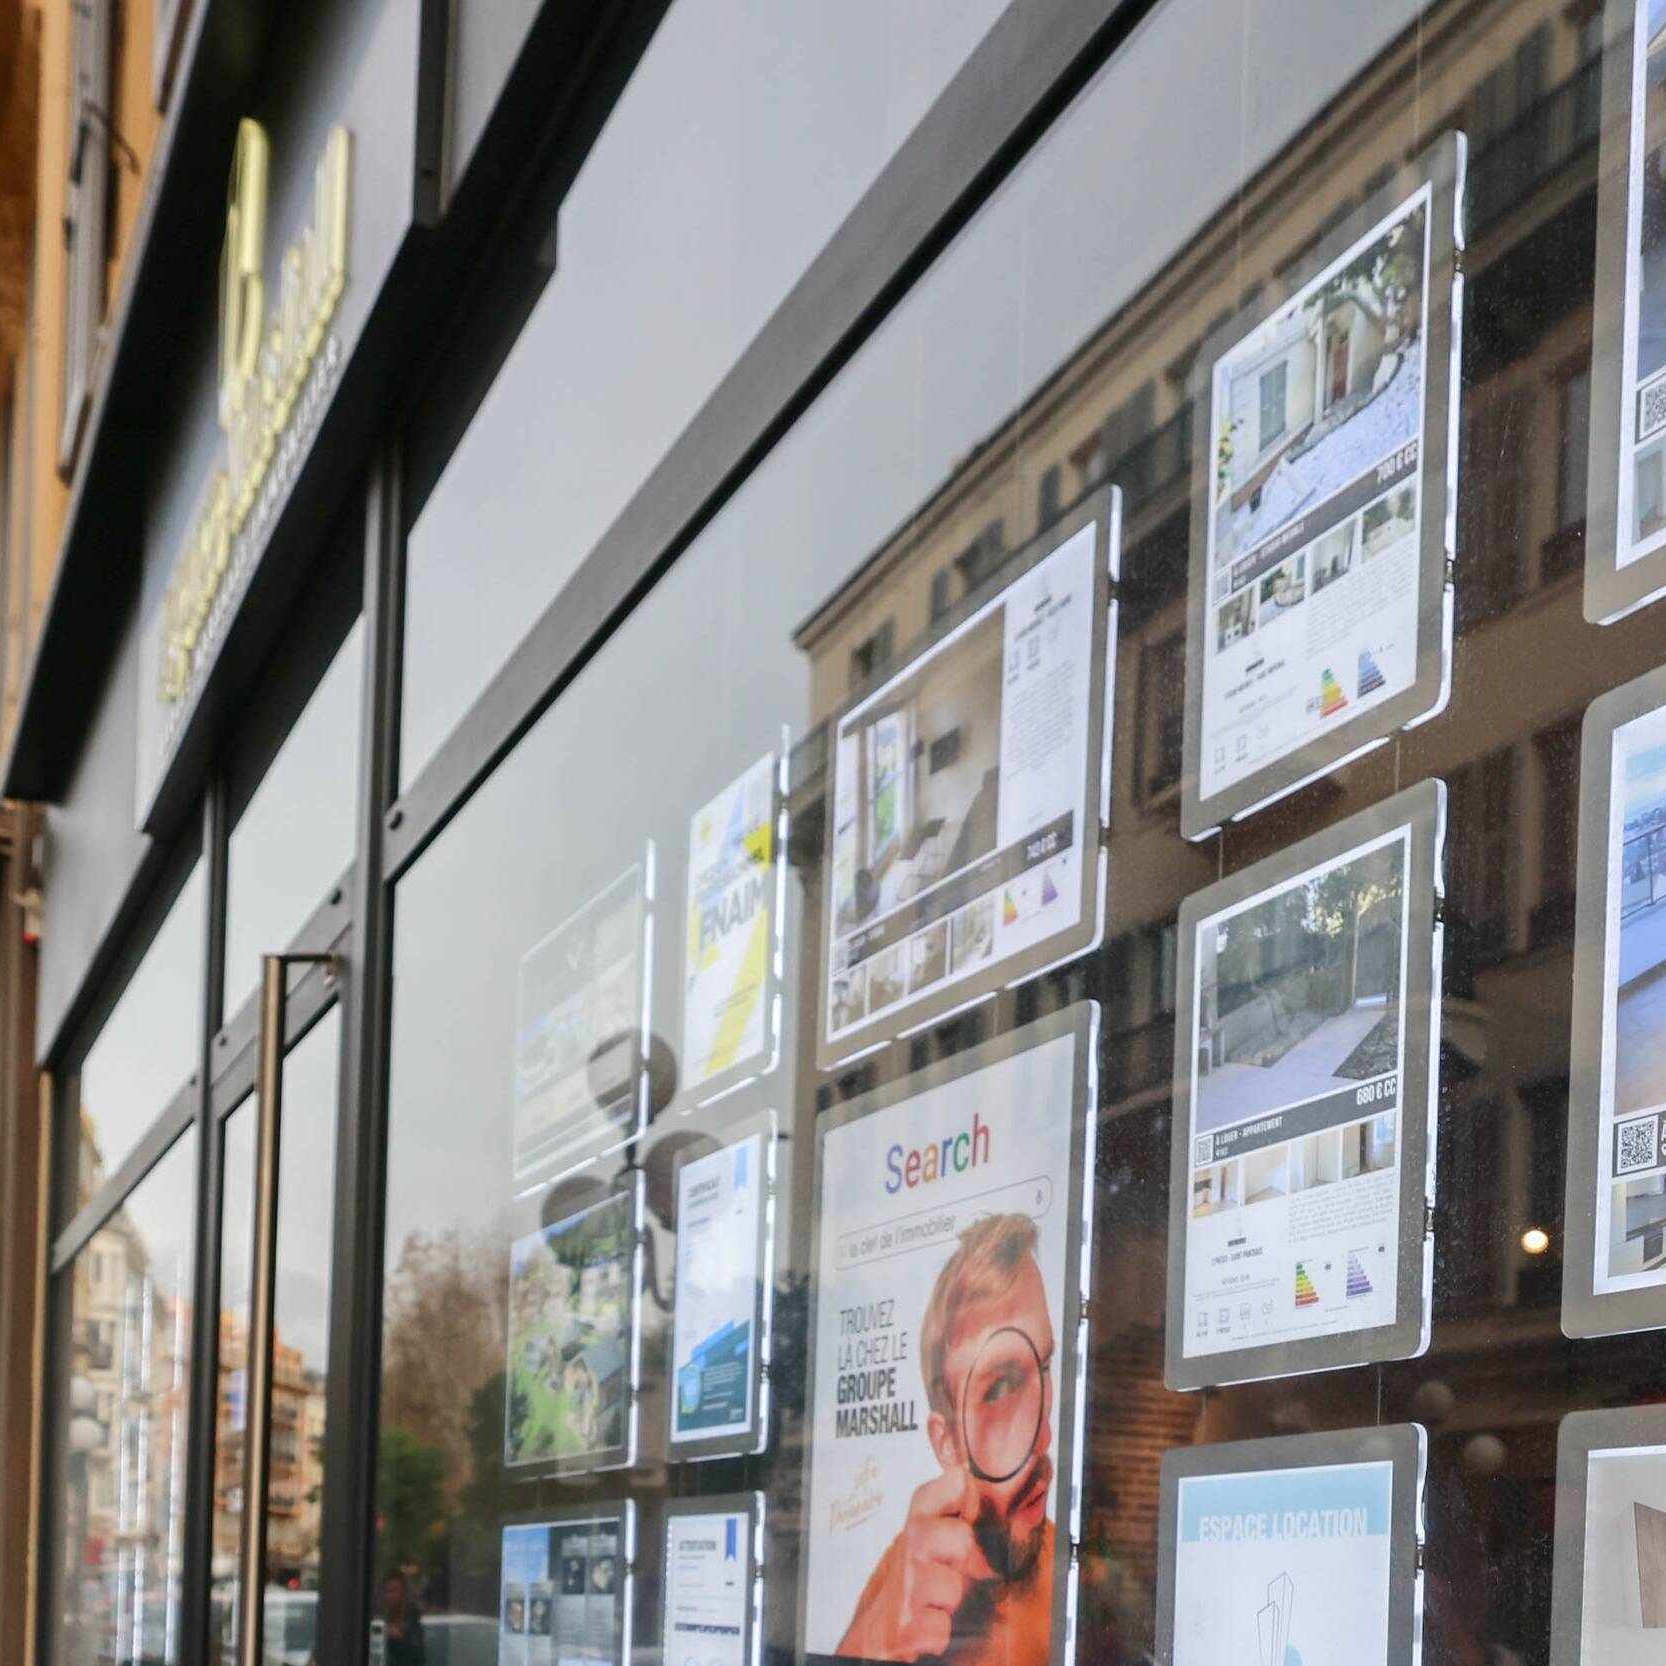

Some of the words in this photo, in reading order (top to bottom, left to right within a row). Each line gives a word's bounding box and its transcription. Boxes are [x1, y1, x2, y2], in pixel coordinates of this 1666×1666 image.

[1356, 1083, 1374, 1105] 680
[1376, 1082, 1383, 1100] €
[1383, 1077, 1397, 1097] CC
[885, 1112, 990, 1194] Search
[840, 1299, 895, 1336] TROUVEZ
[856, 1335, 888, 1368] CHEZ
[893, 1332, 908, 1361] LE
[837, 1367, 896, 1404] GROUPE
[835, 1400, 918, 1439] MARSHALL
[1199, 1513, 1267, 1543] ESPACE
[1272, 1507, 1367, 1541] LOCATION
